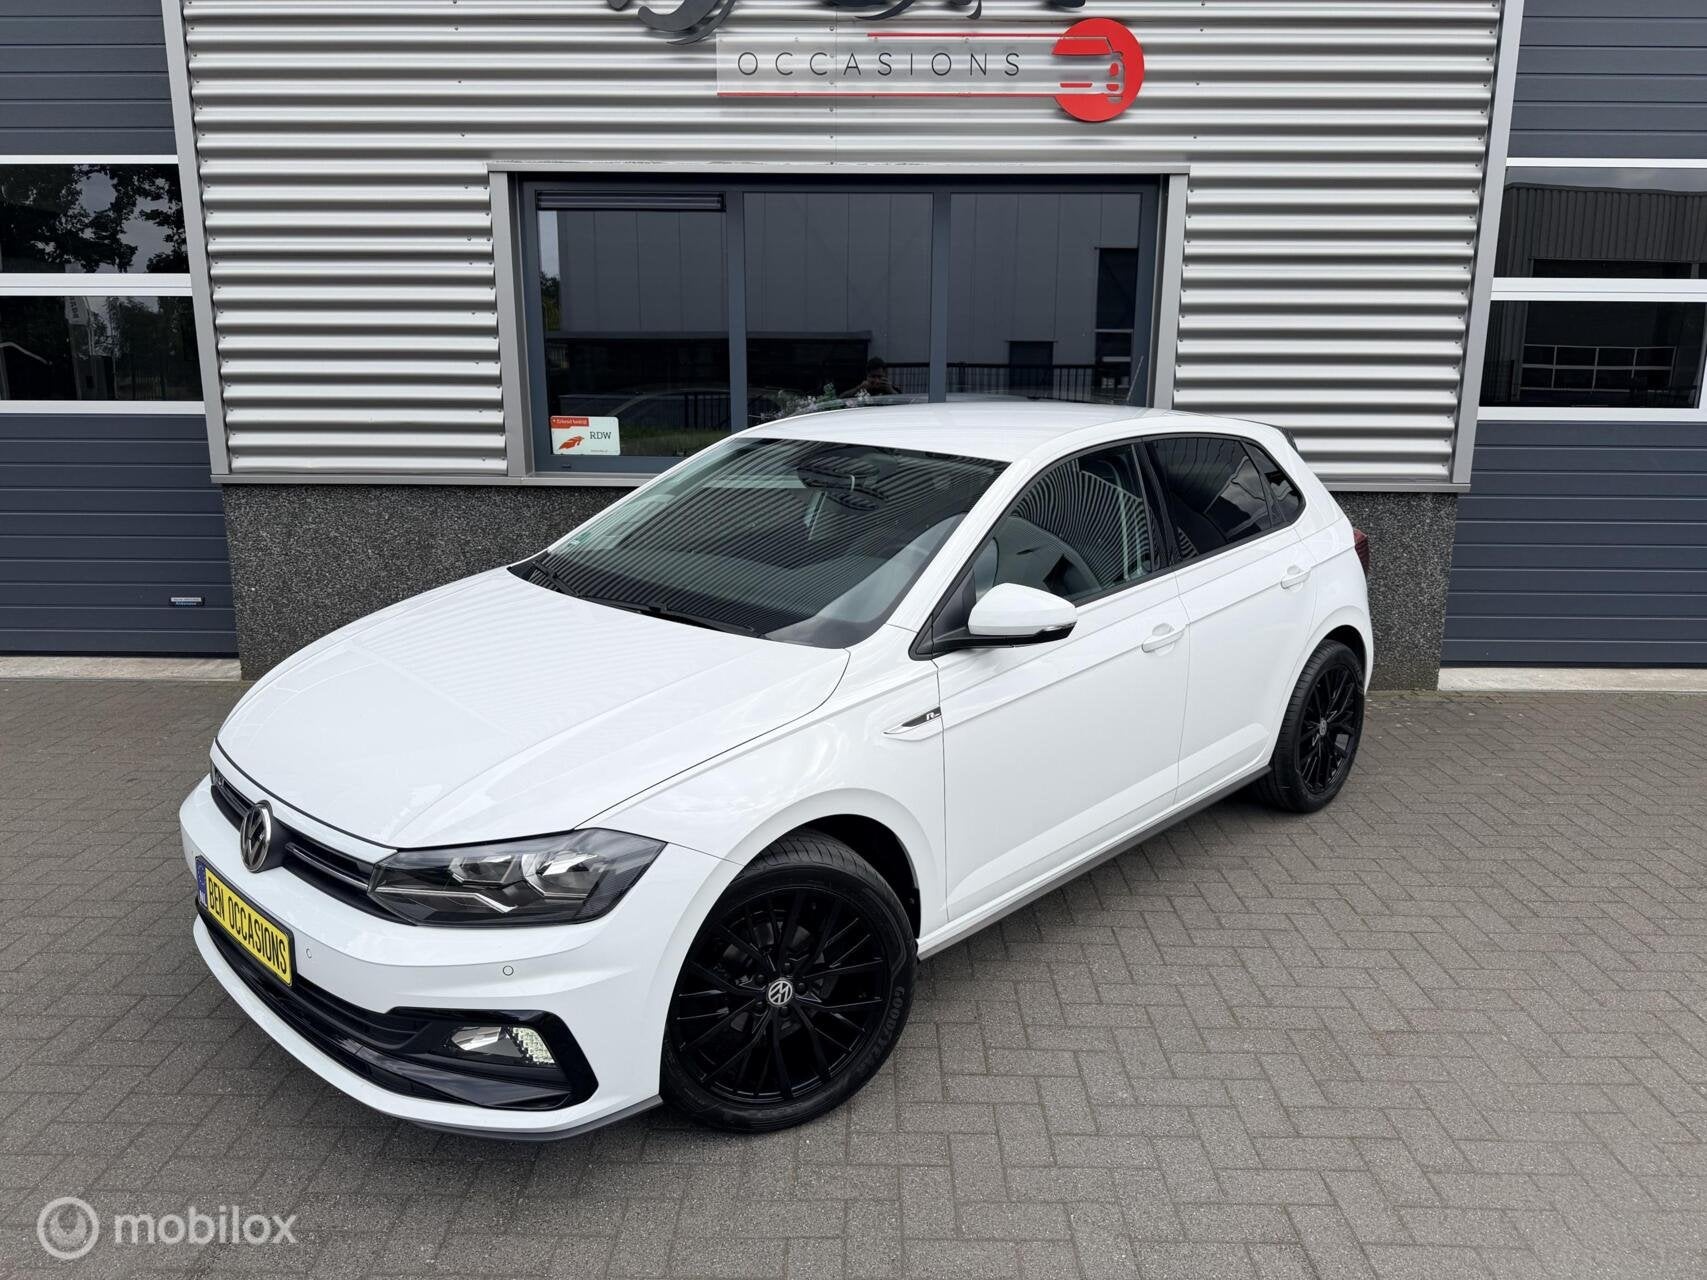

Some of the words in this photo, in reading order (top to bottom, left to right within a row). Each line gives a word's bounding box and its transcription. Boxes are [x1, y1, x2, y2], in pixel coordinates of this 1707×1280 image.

[737, 52, 1021, 77] OCCASIONS
[589, 431, 611, 440] RDW
[208, 877, 225, 919] BEN
[228, 895, 287, 975] OCCASIONS
